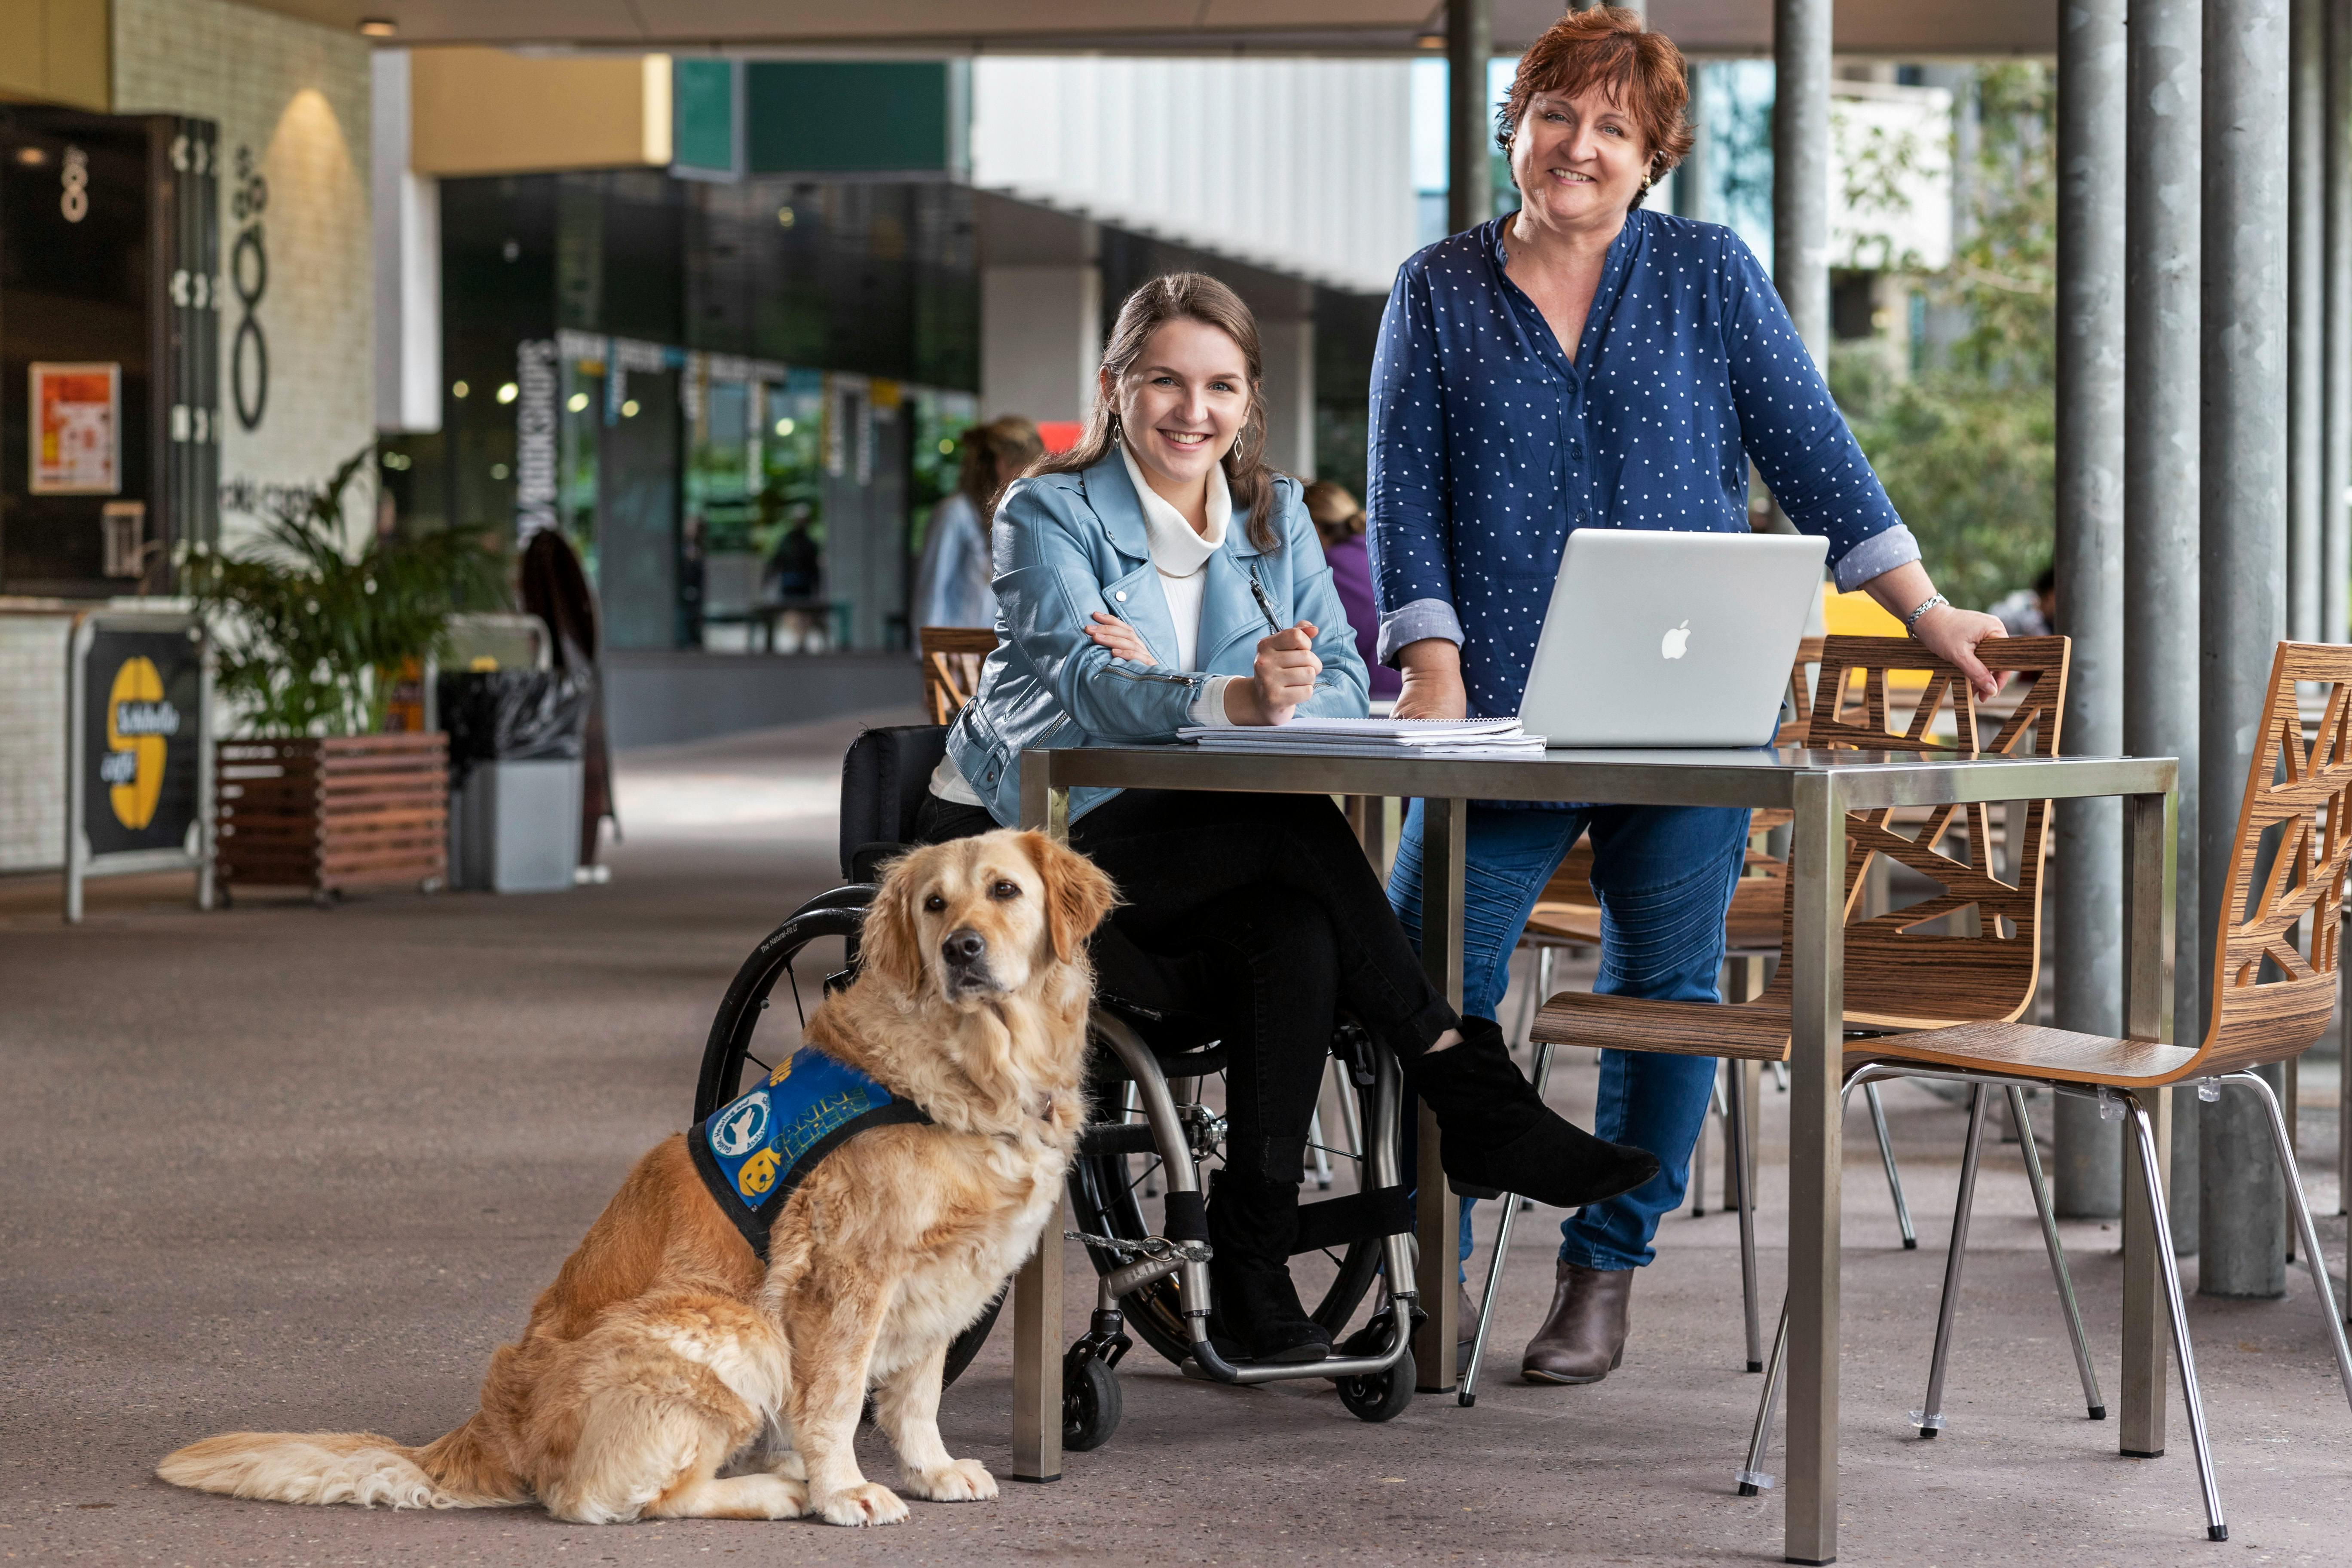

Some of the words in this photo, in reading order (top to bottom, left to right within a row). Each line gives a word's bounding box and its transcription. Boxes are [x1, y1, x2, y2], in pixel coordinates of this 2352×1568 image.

[760, 943, 770, 954] The
[769, 927, 793, 946] Natural-Fit
[793, 924, 798, 932] LT
[714, 1110, 735, 1138] Hearing
[736, 1099, 750, 1111] and
[747, 1129, 765, 1150] Assist
[769, 1086, 864, 1154] CANINE
[781, 1095, 870, 1166] HELPERS
